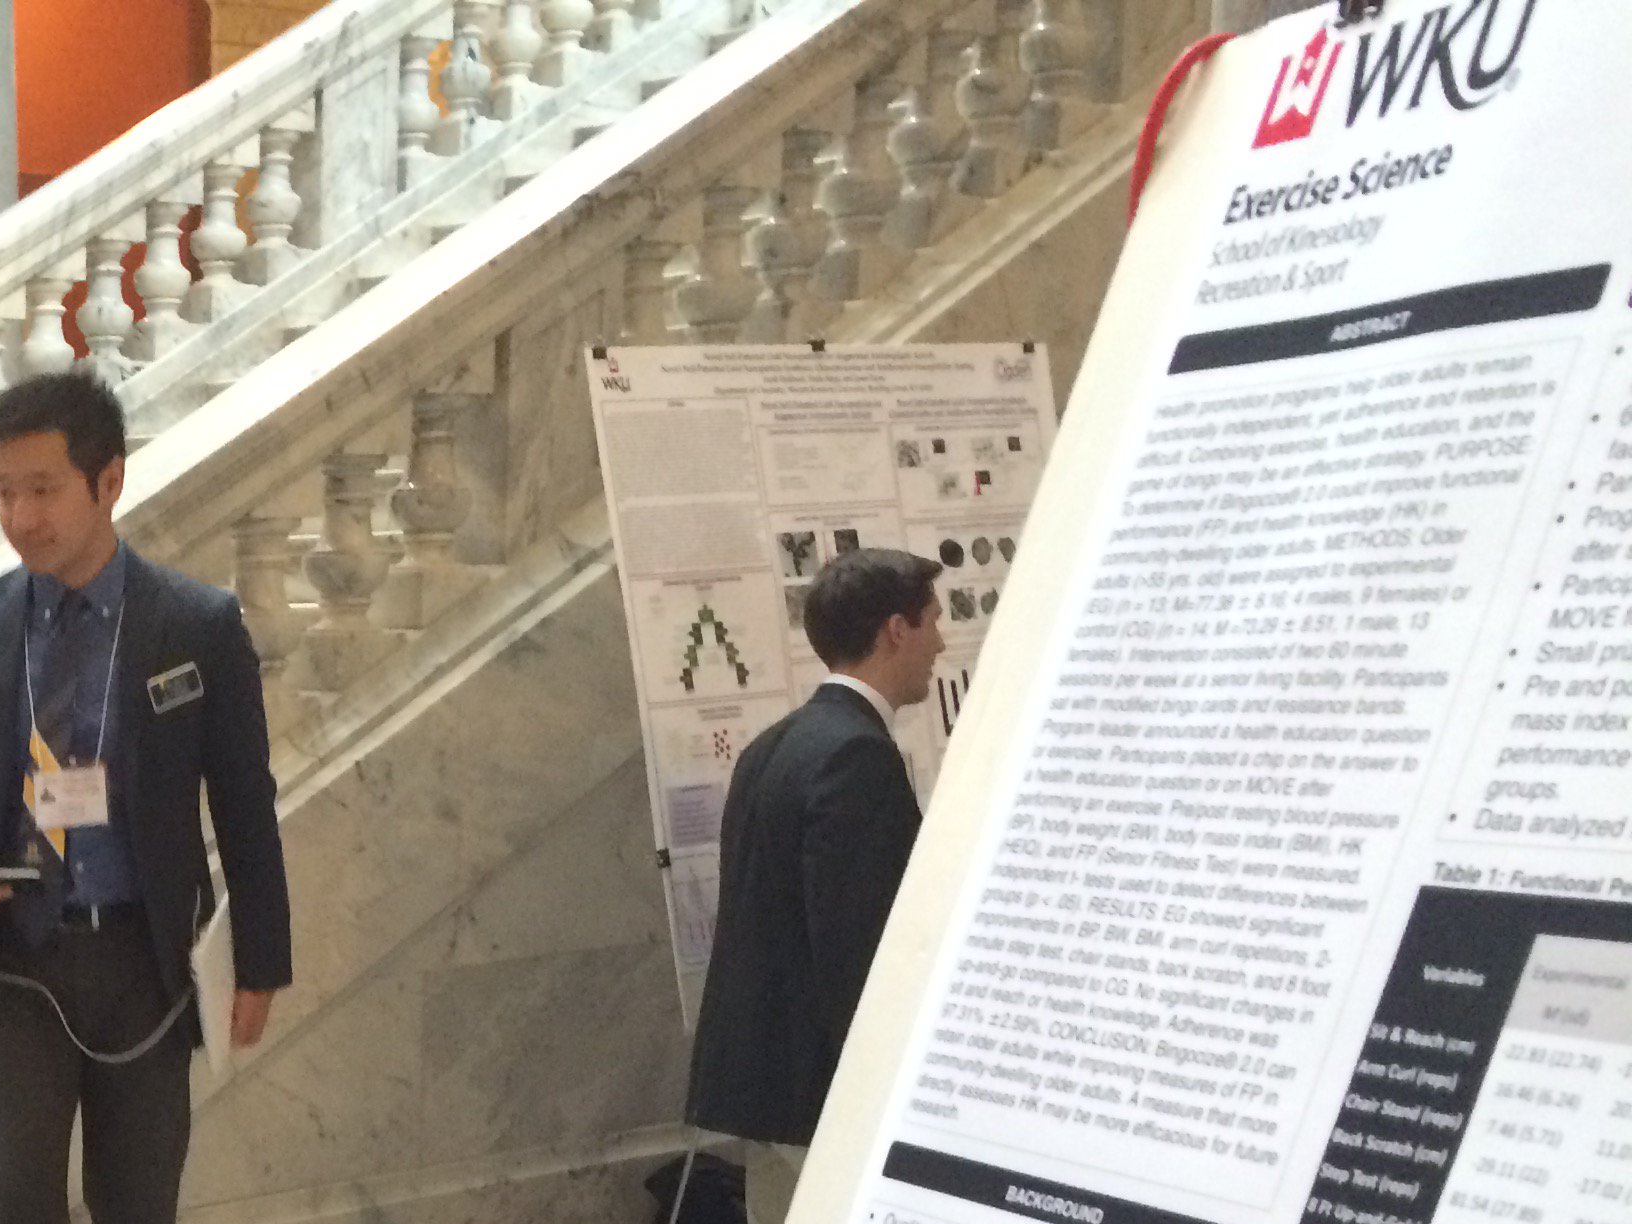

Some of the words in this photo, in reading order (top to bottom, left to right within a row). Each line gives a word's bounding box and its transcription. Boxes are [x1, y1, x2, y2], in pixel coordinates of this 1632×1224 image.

[1345, 0, 1536, 128] WKU
[1223, 170, 1339, 226] Exercise
[1341, 143, 1453, 201] Science
[1208, 227, 1265, 270] School
[1282, 212, 1386, 259] Kinesiology
[1195, 267, 1284, 307] Recreation
[1301, 256, 1351, 295] Sport
[1329, 308, 1414, 344] ABSTRACT
[601, 377, 631, 393] WKU
[1474, 808, 1523, 832] Data
[1528, 813, 1627, 841] analyzed
[1433, 861, 1482, 884] Table
[1509, 869, 1604, 895] Functional
